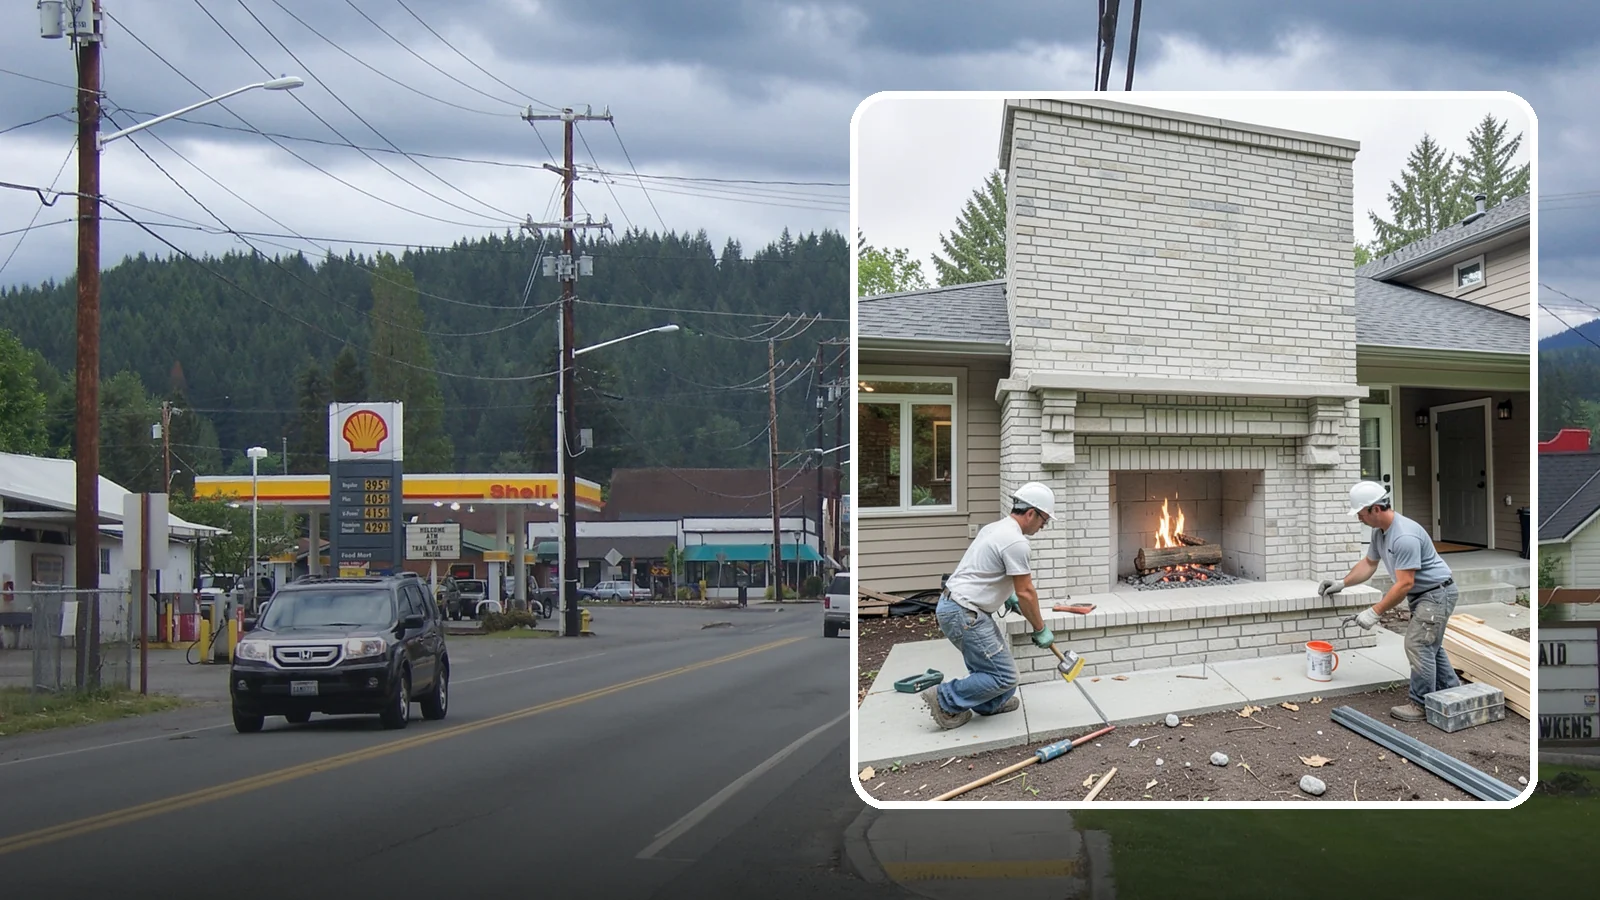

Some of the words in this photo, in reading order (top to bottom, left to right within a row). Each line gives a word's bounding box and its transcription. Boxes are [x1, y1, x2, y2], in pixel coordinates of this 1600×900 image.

[365, 480, 384, 490] 395
[490, 484, 547, 499] Shell
[365, 494, 384, 504] 405
[365, 508, 384, 518] 415
[365, 522, 384, 533] 429
